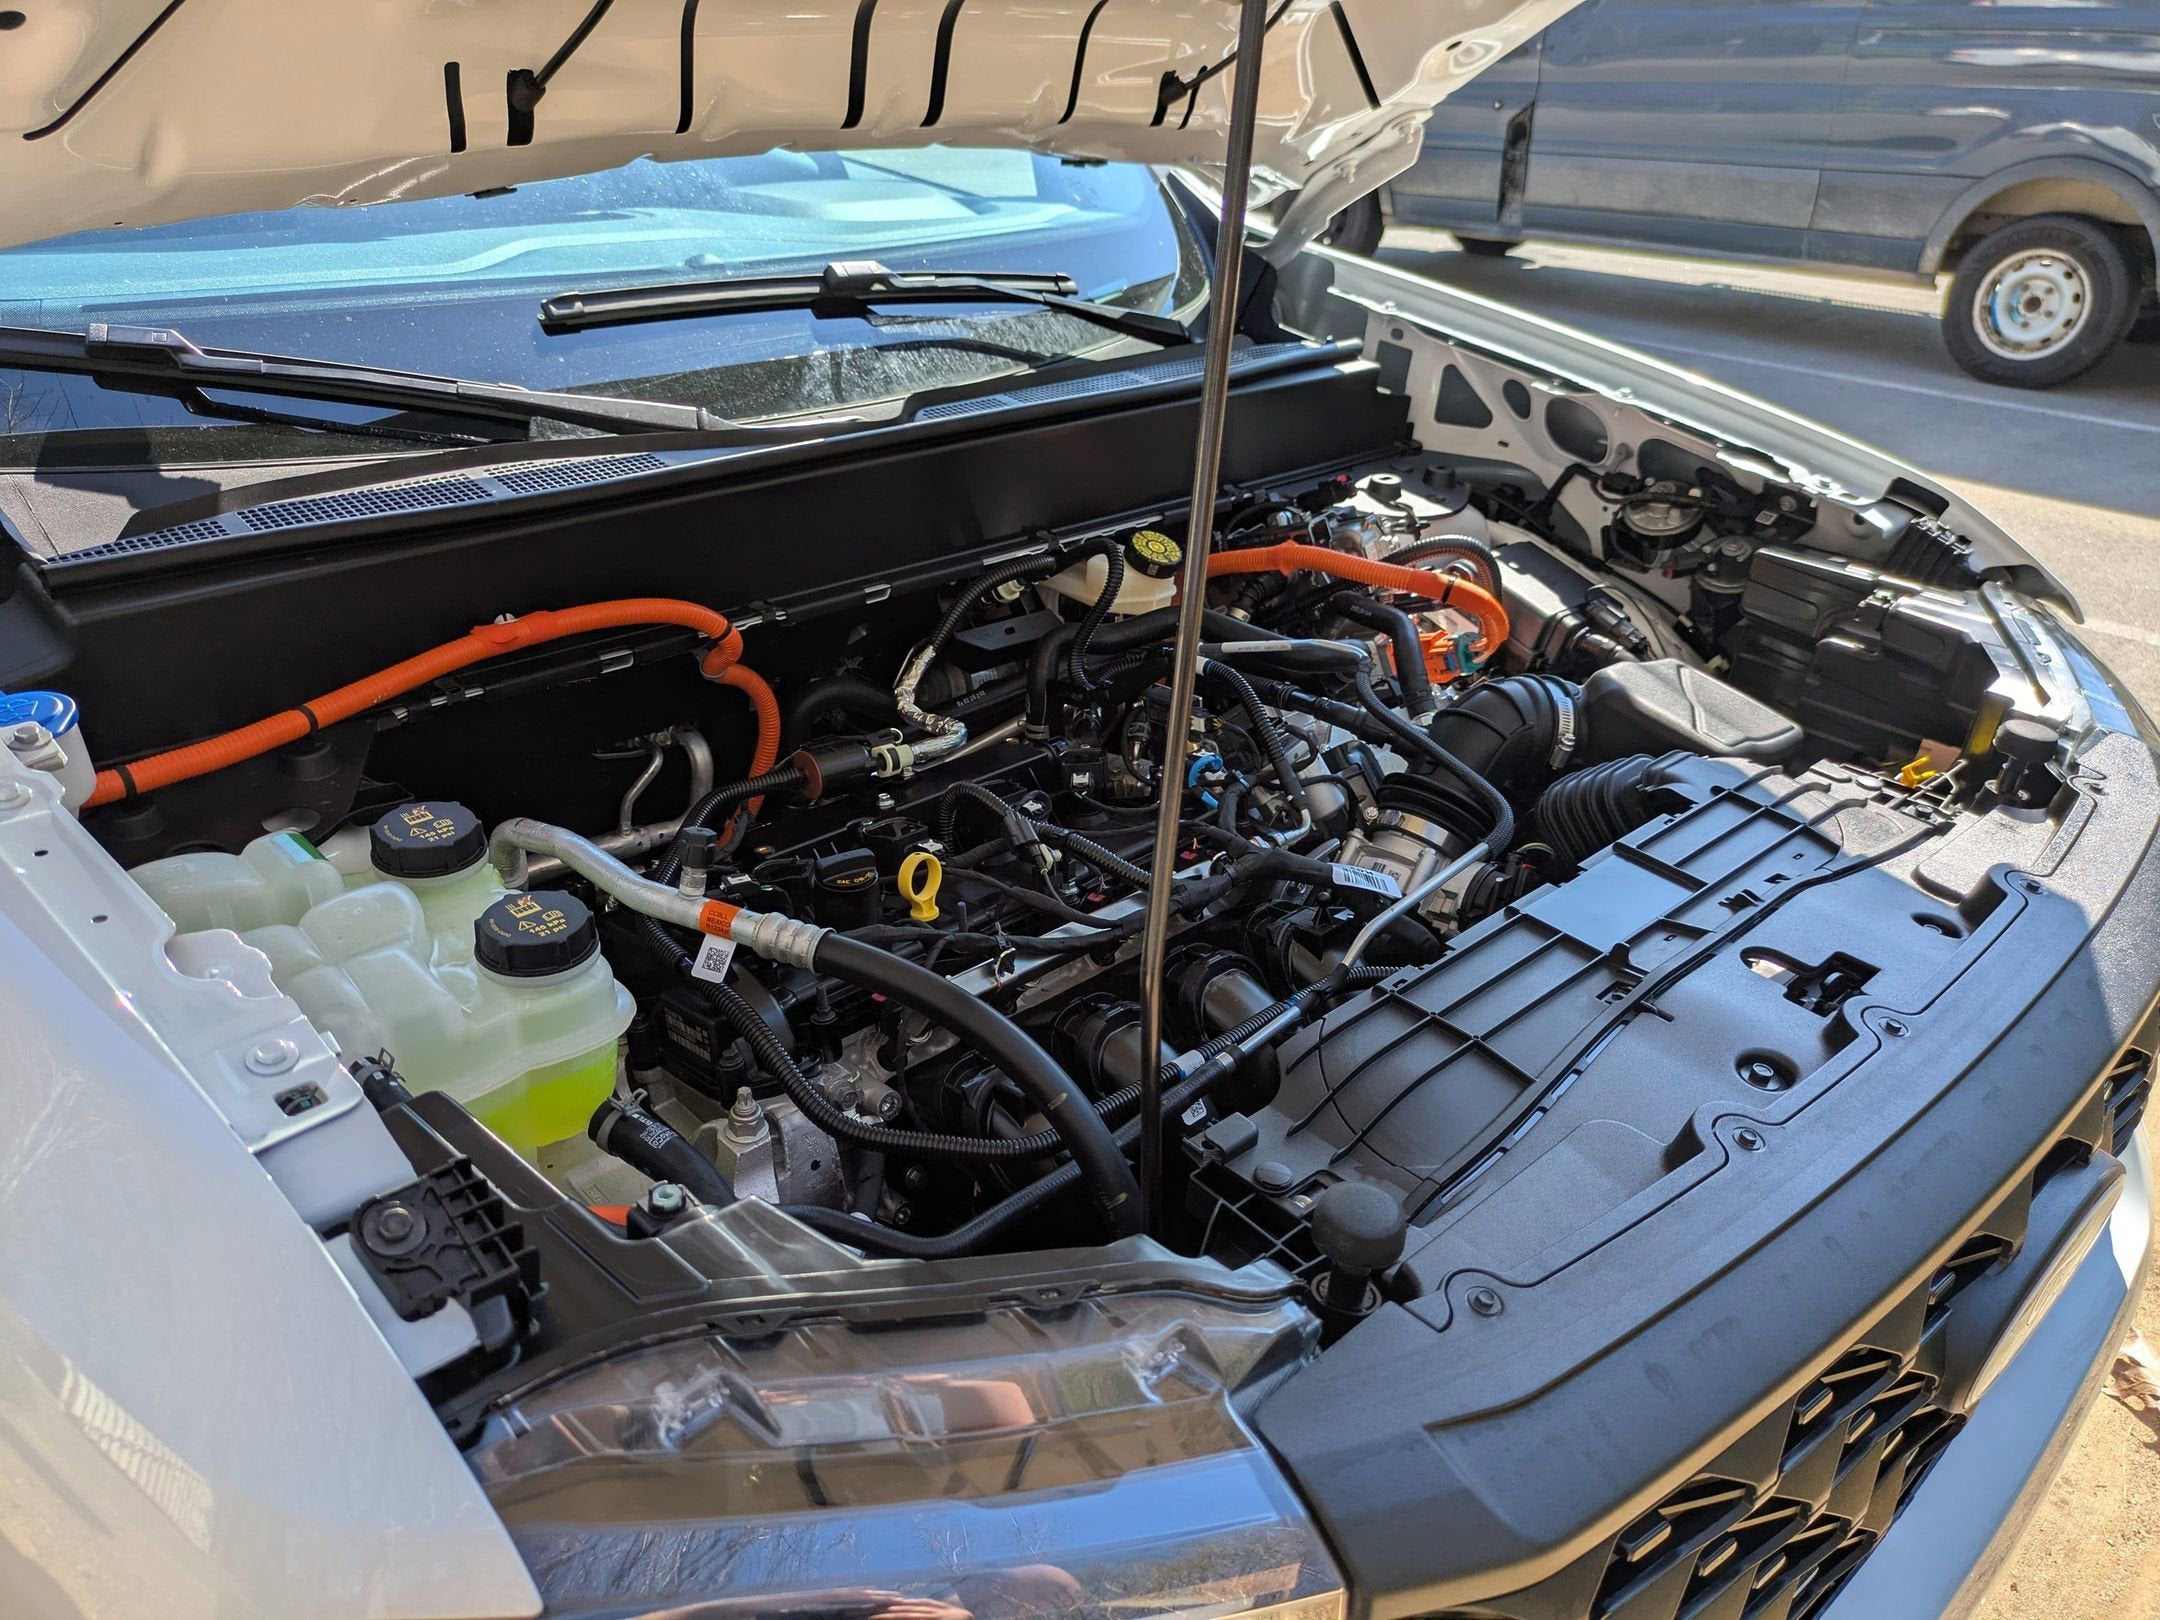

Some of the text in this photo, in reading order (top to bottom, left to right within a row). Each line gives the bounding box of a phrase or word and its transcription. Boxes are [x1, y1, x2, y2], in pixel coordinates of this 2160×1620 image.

[419, 826, 455, 840] 145 kPa
[441, 830, 455, 839] psi
[529, 918, 566, 934] 145 kPa
[552, 923, 567, 933] psi
[706, 915, 731, 928] MEXICO
